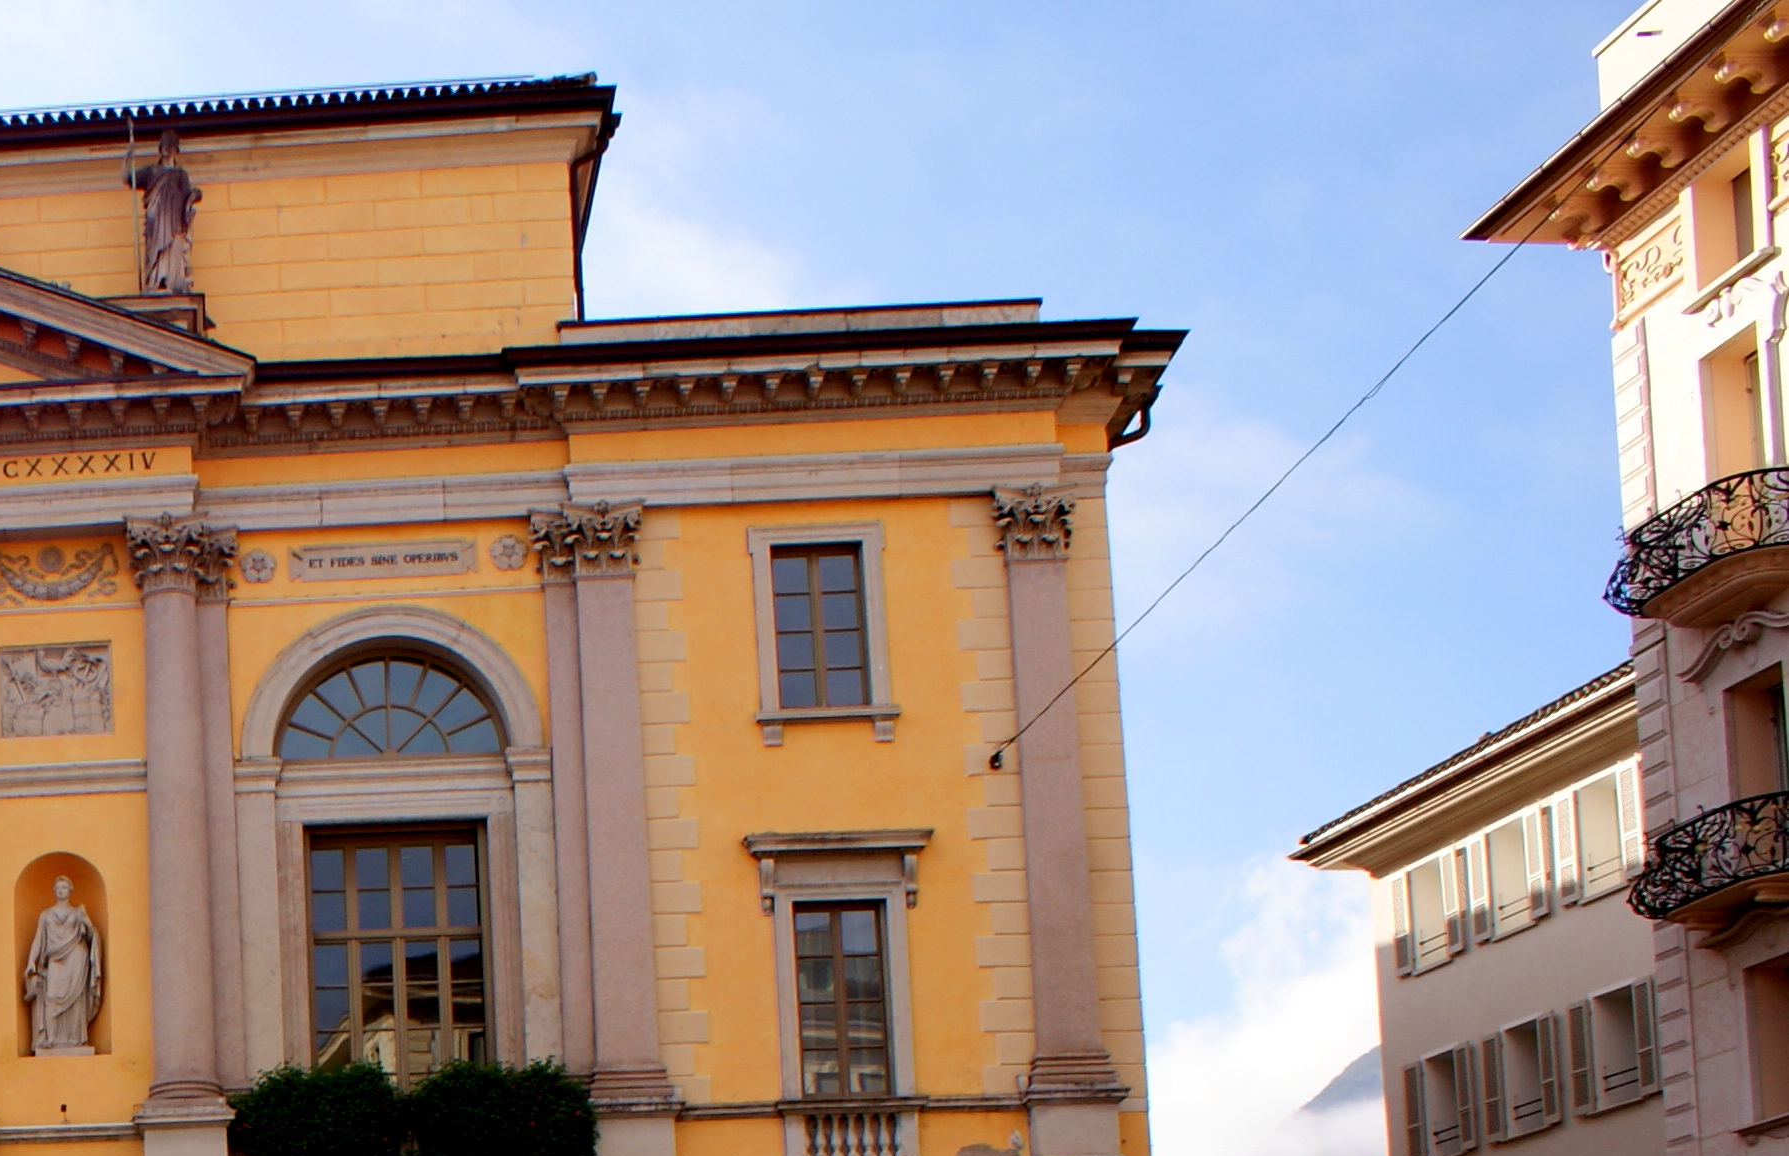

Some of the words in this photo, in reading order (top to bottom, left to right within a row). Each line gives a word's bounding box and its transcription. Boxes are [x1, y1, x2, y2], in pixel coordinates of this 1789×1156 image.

[308, 558, 323, 568] ET
[330, 556, 365, 568] FIDES
[371, 554, 397, 566] SINE
